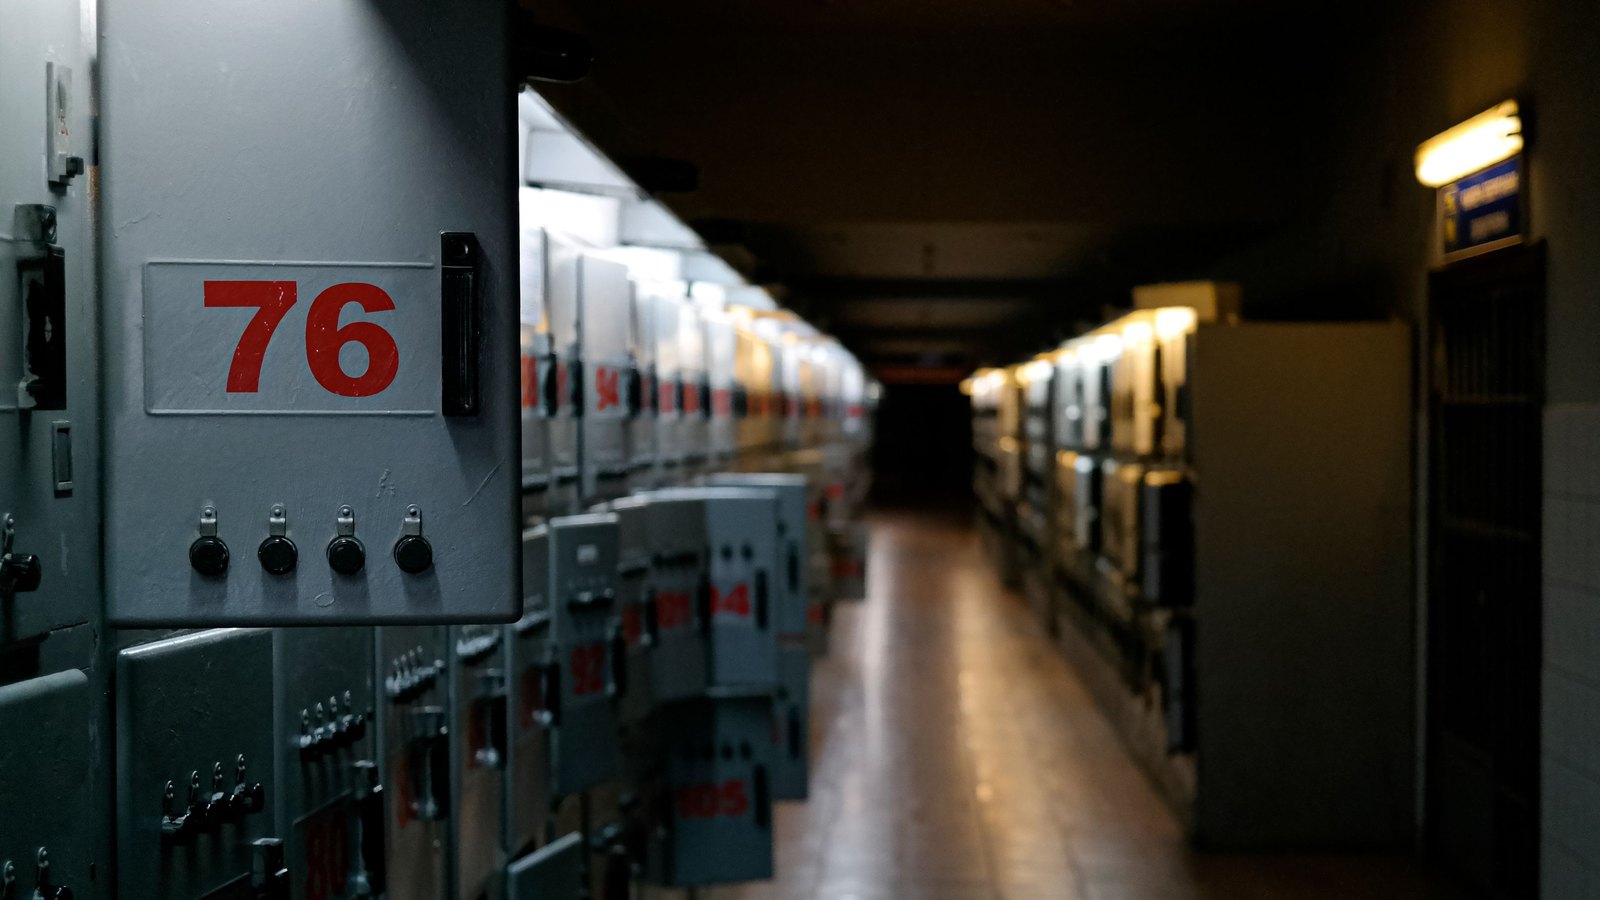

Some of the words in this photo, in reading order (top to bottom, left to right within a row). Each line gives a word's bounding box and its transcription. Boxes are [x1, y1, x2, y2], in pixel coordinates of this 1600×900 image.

[203, 280, 399, 397] 76
[595, 366, 620, 411] 94
[306, 809, 349, 900] 80
